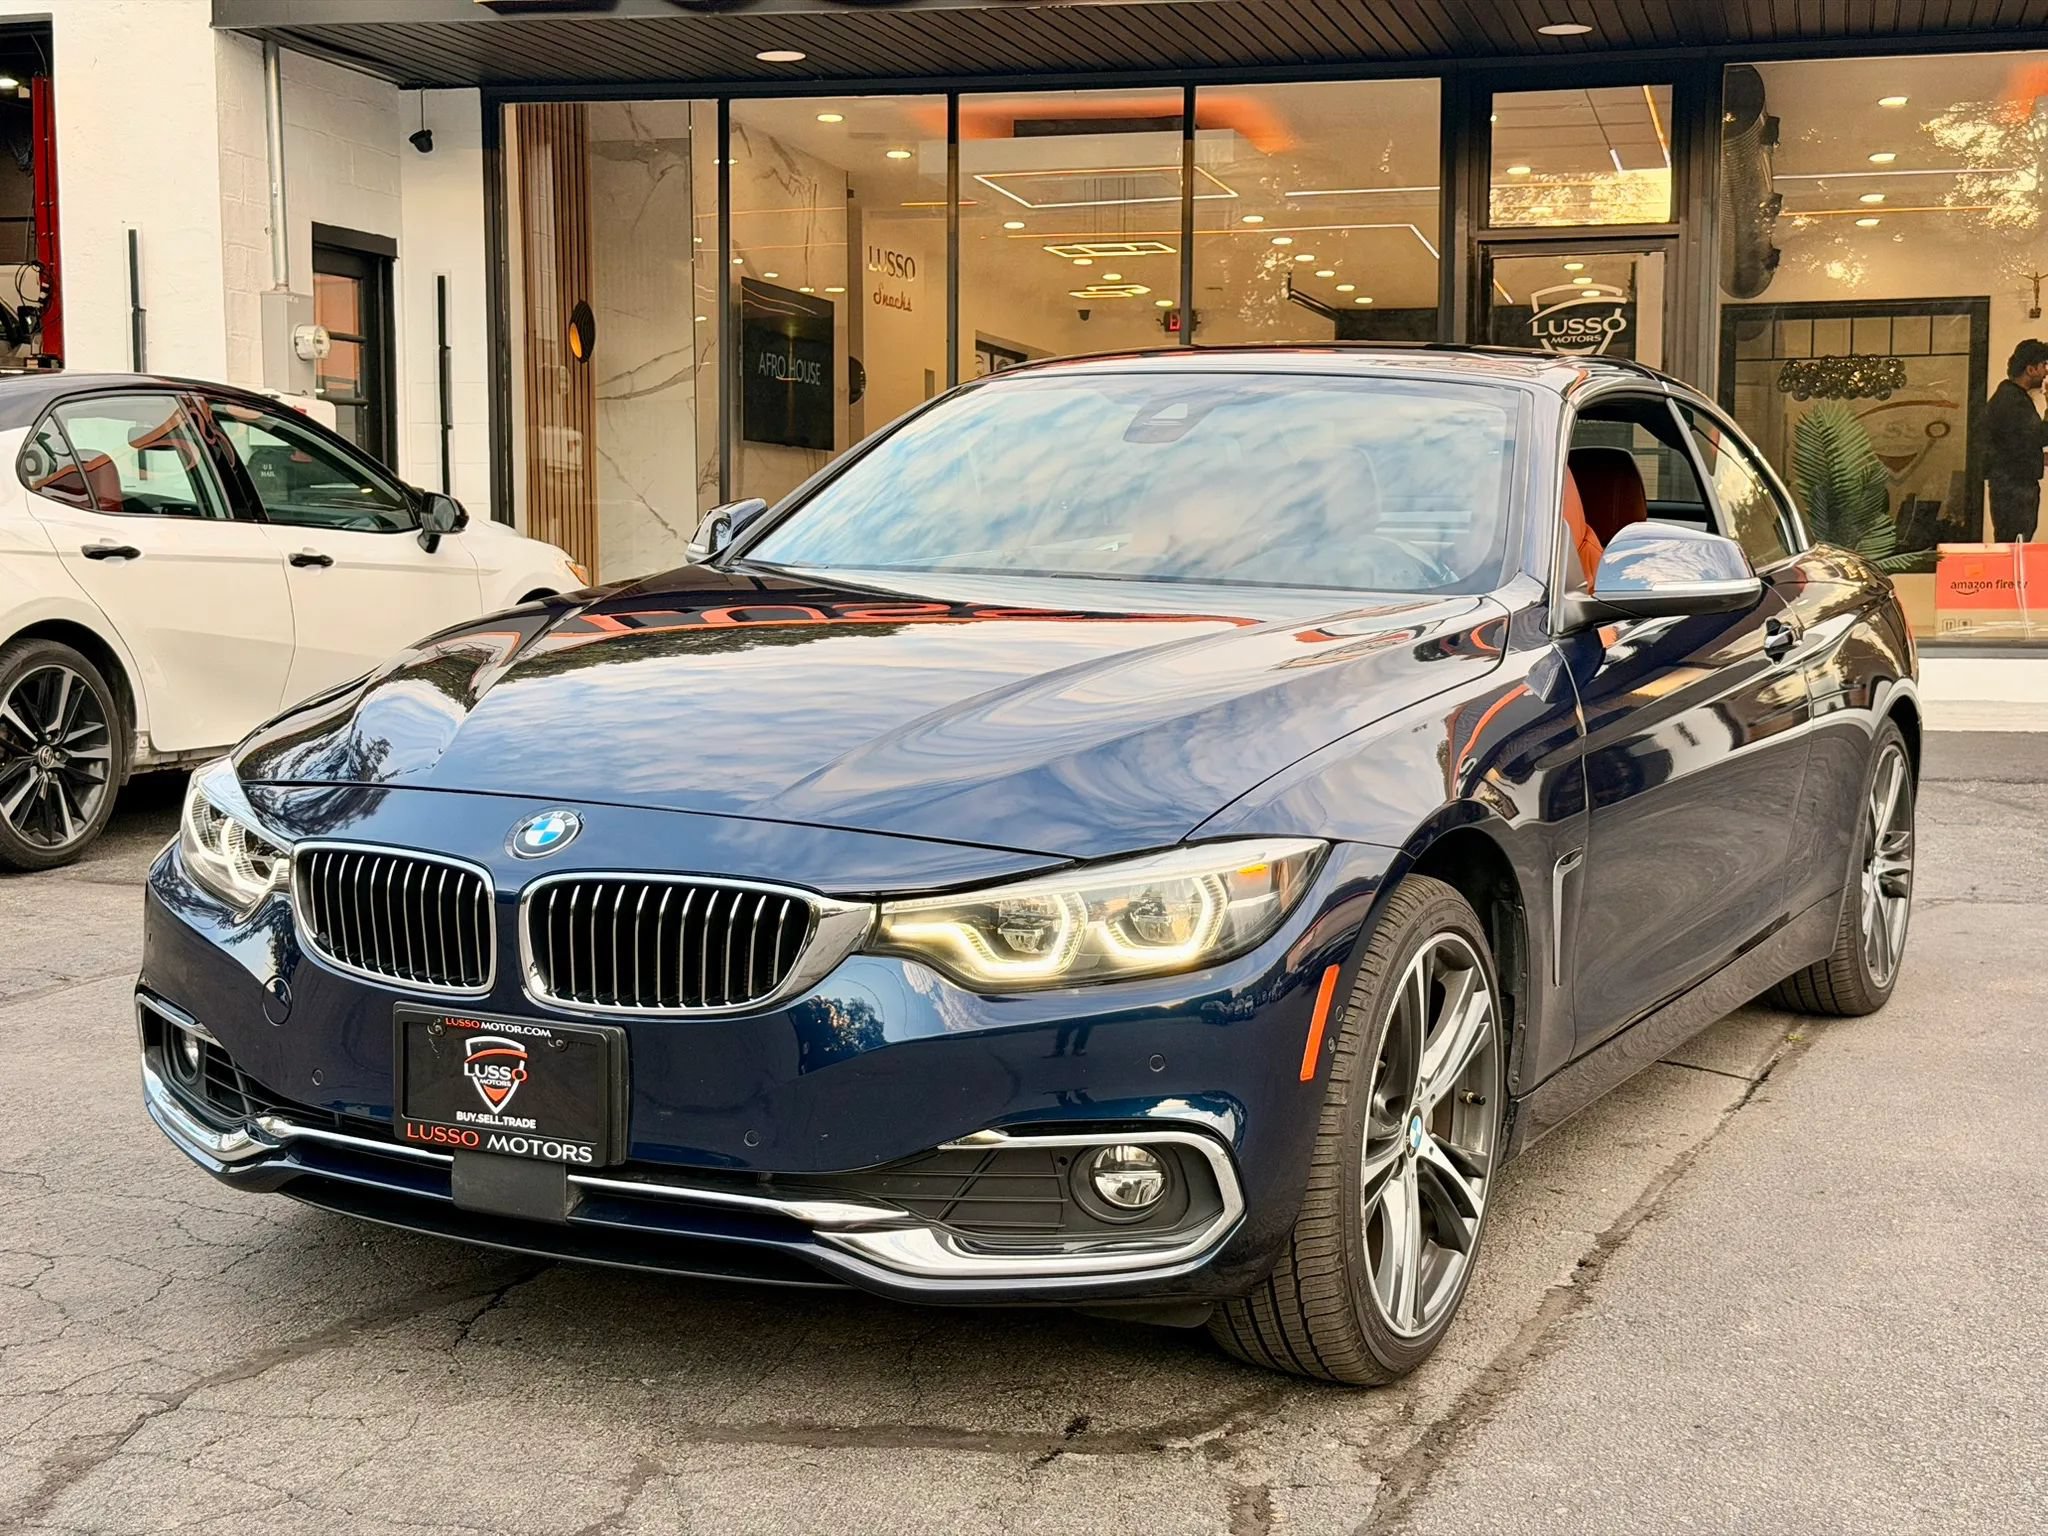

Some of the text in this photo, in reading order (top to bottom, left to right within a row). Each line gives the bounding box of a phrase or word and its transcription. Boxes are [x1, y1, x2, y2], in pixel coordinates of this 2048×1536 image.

[868, 245, 916, 282] LUSSO
[1532, 317, 1627, 336] LUSSO
[1550, 335, 1602, 344] MOTORS
[758, 352, 822, 386] AFRO HOUSE
[1950, 580, 1993, 591] amazon
[1995, 579, 2015, 590] fire
[464, 1062, 528, 1081] LUSSO
[480, 1079, 512, 1087] MOTORS
[407, 1122, 593, 1163] LUSSO MOTORS
